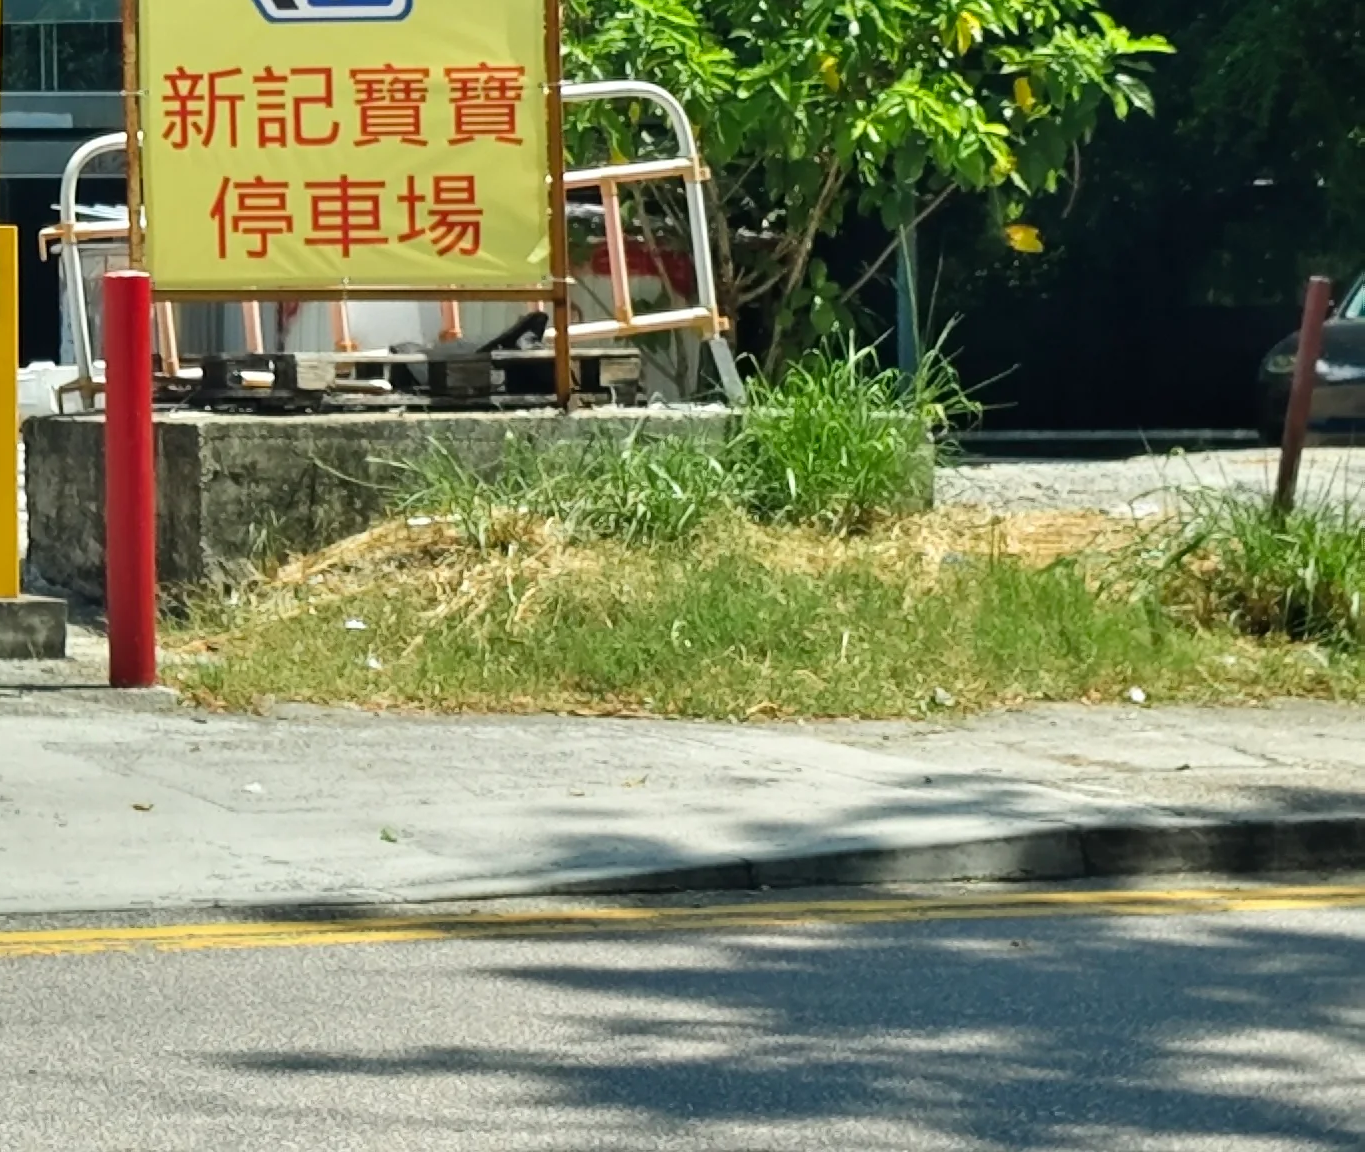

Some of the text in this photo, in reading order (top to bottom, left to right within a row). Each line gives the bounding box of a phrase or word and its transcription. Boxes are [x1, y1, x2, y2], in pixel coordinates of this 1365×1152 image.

[161, 61, 526, 150] 新記寶寶
[209, 173, 484, 260] 停車場
